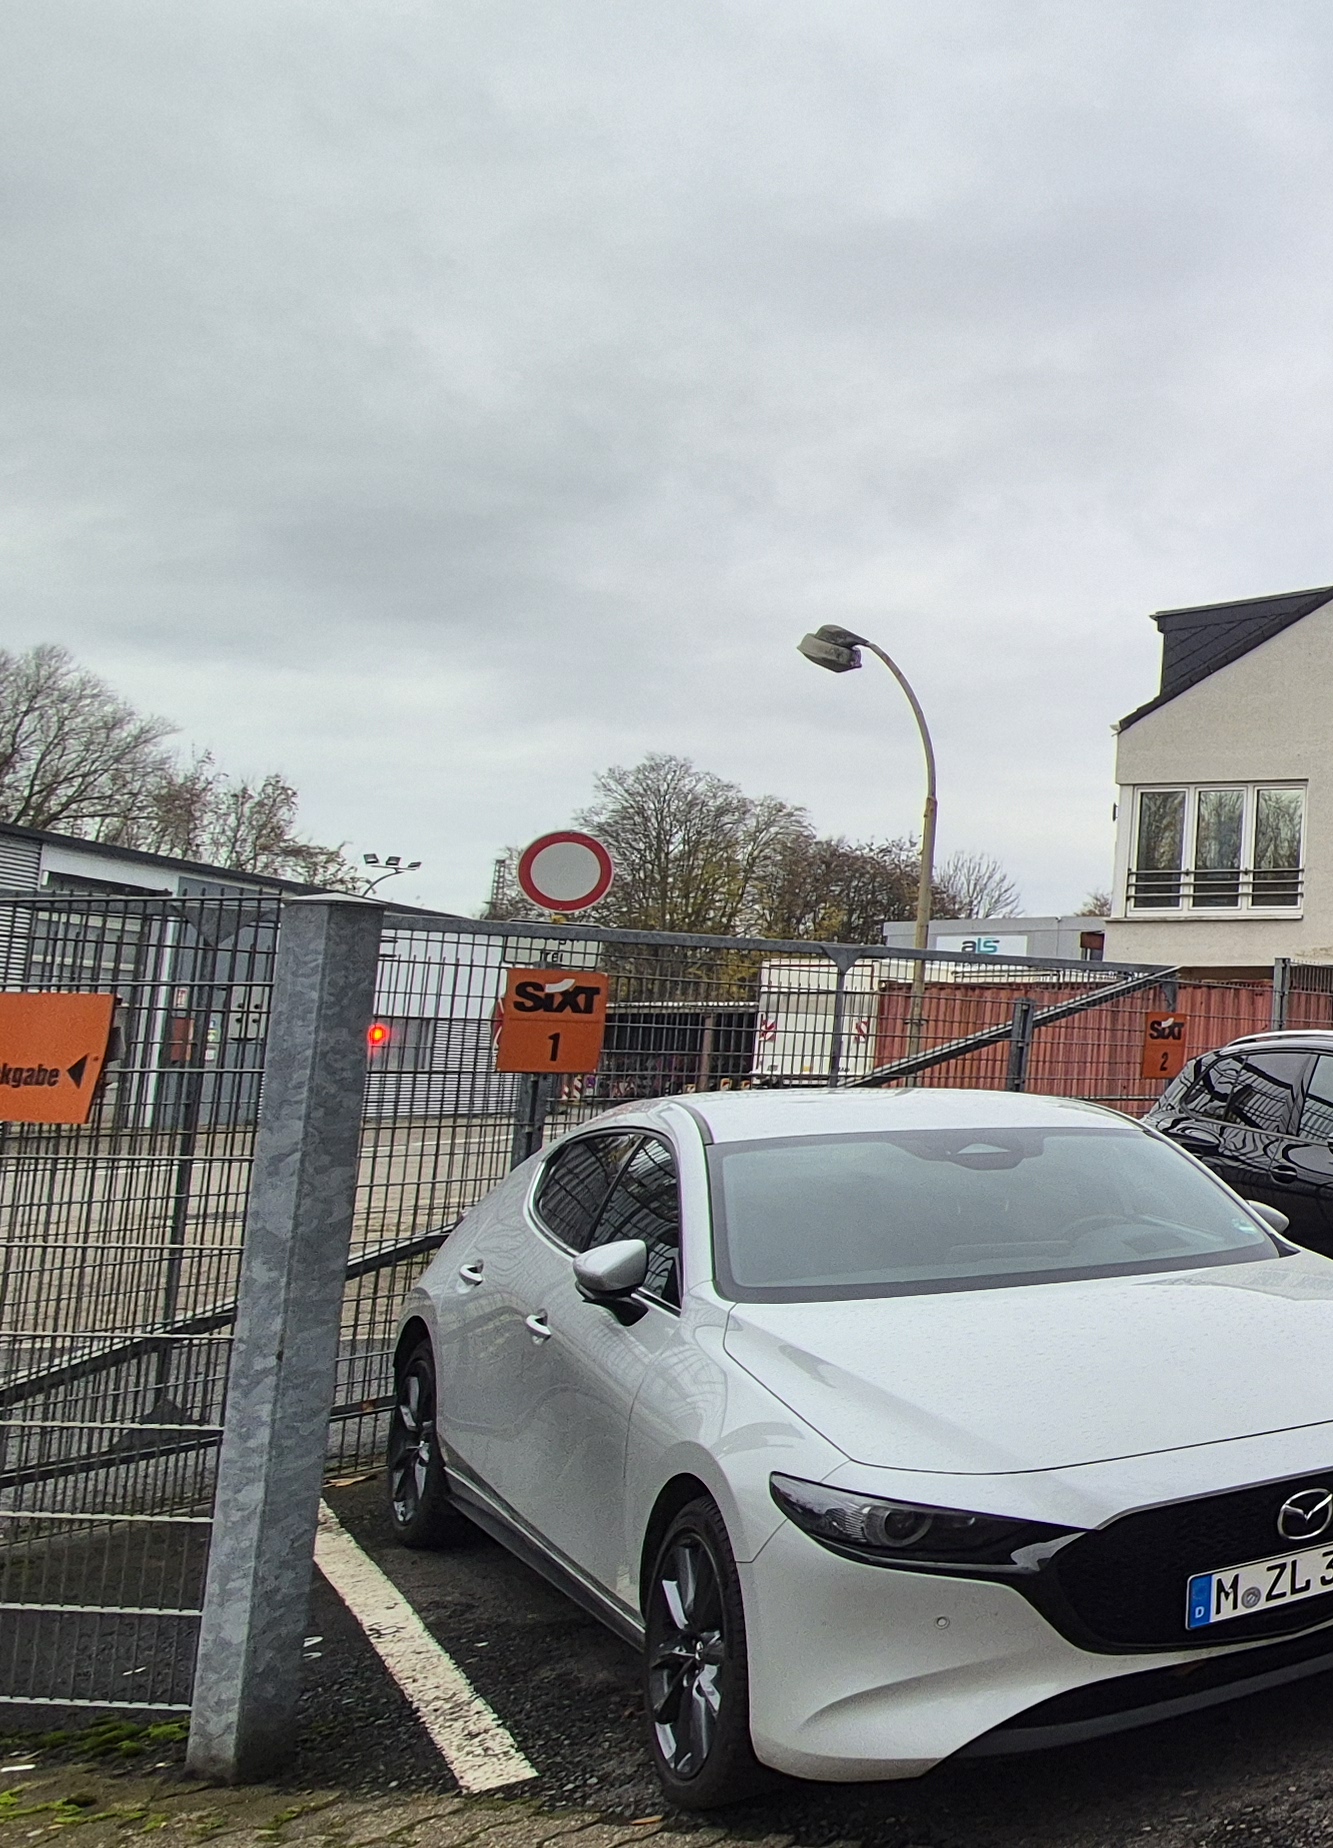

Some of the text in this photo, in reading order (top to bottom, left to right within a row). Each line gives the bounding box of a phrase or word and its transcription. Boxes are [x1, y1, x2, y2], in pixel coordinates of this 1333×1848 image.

[513, 979, 601, 1015] SIXT
[1149, 1017, 1185, 1041] SIXT
[548, 1032, 560, 1062] 1
[1160, 1052, 1169, 1072] 2
[1215, 1573, 1240, 1615] M
[1265, 1559, 1311, 1602] ZL
